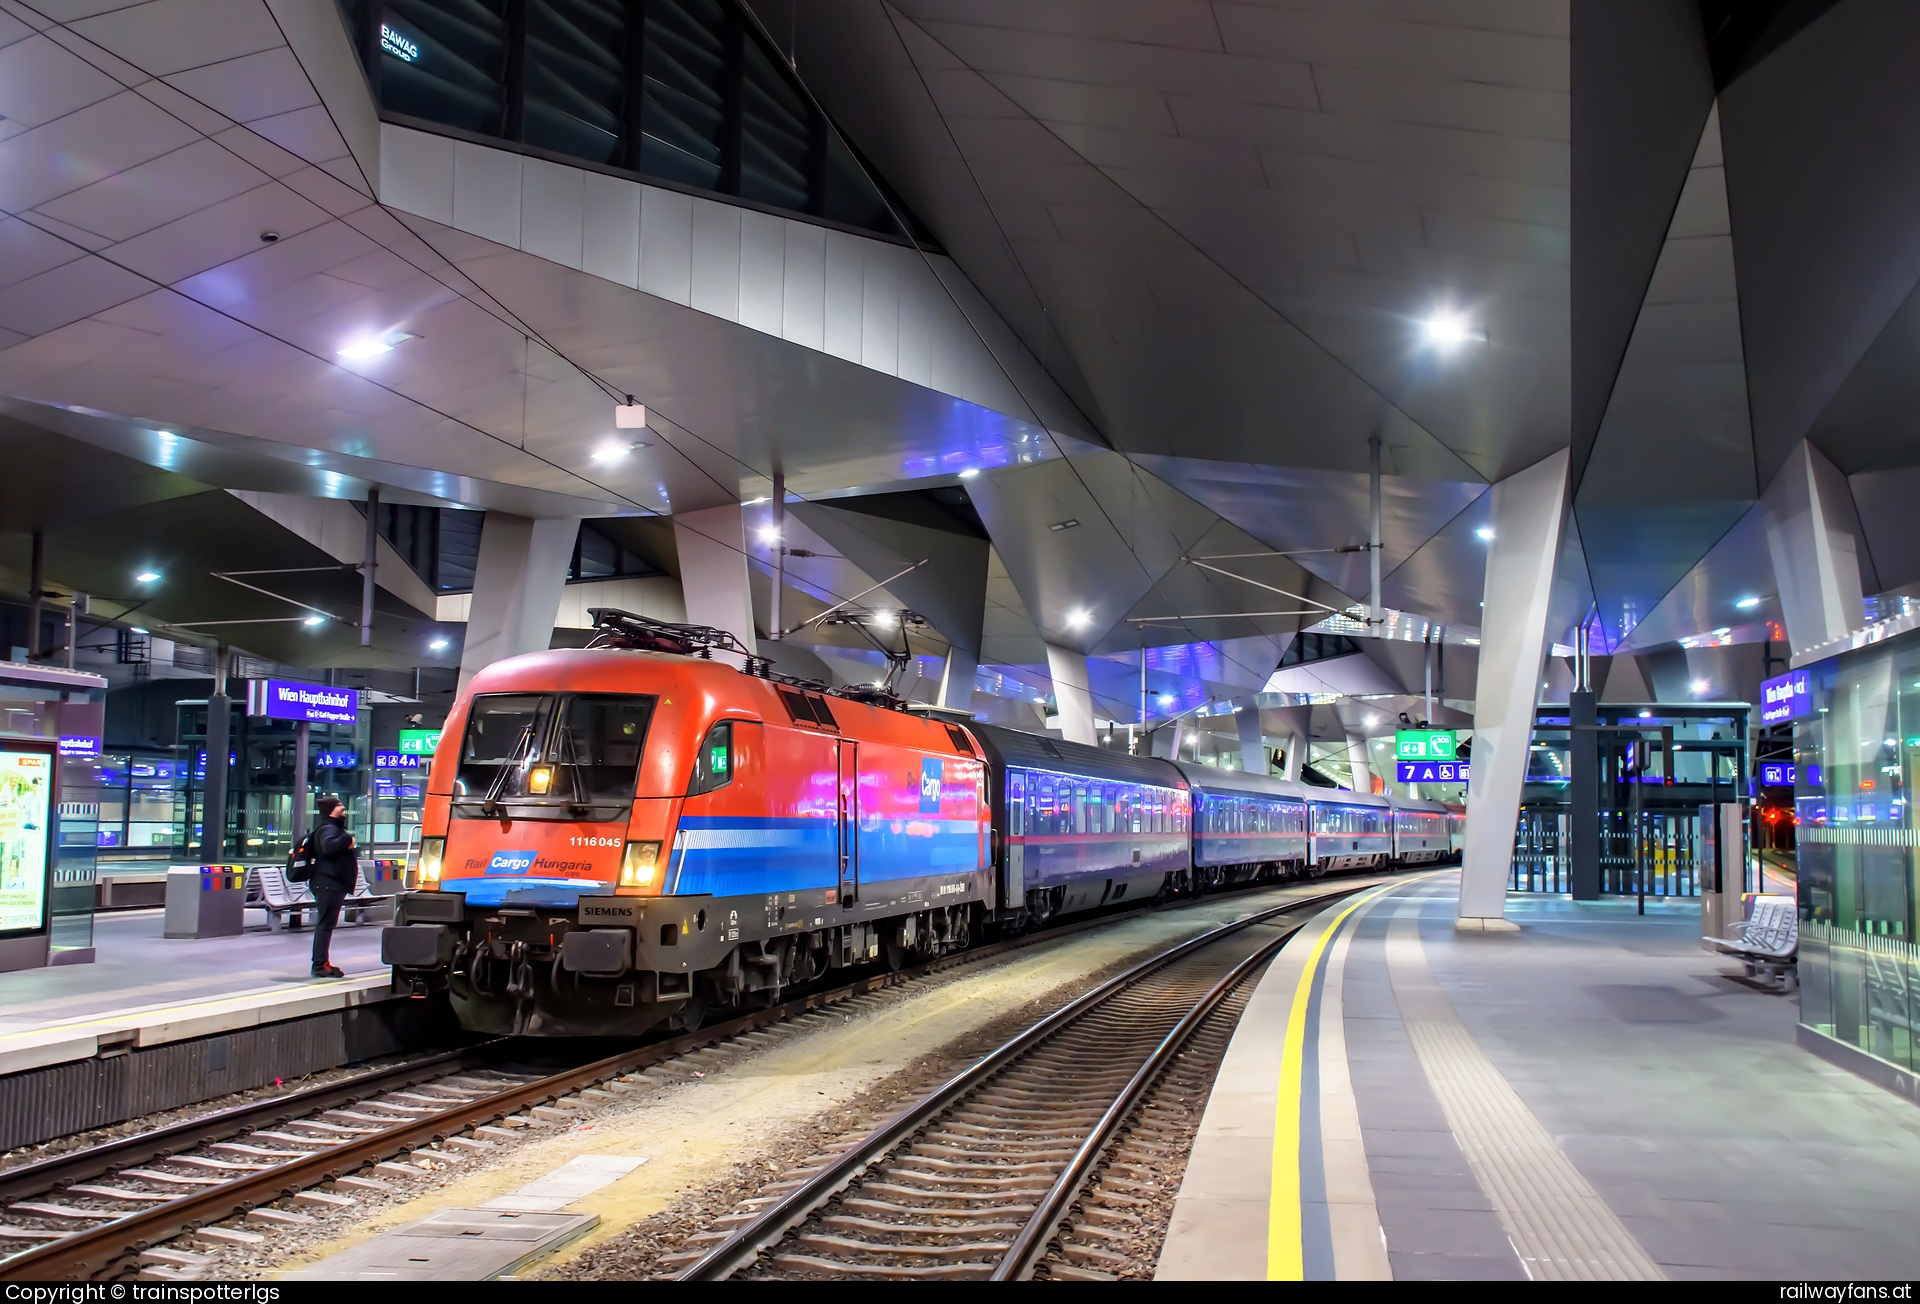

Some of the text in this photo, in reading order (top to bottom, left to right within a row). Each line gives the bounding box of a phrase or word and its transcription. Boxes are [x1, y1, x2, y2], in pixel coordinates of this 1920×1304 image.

[381, 24, 418, 58] BAWAG
[381, 39, 410, 61] Group
[278, 687, 349, 707] Wien Hauptbahnhof
[399, 754, 416, 766] 4 A
[1404, 766, 1434, 779] 7 A
[921, 771, 940, 802] Cargo
[569, 837, 621, 848] 1116 045
[464, 856, 593, 872] Rail Cargo Hungaria
[584, 907, 633, 917] SIEMENS
